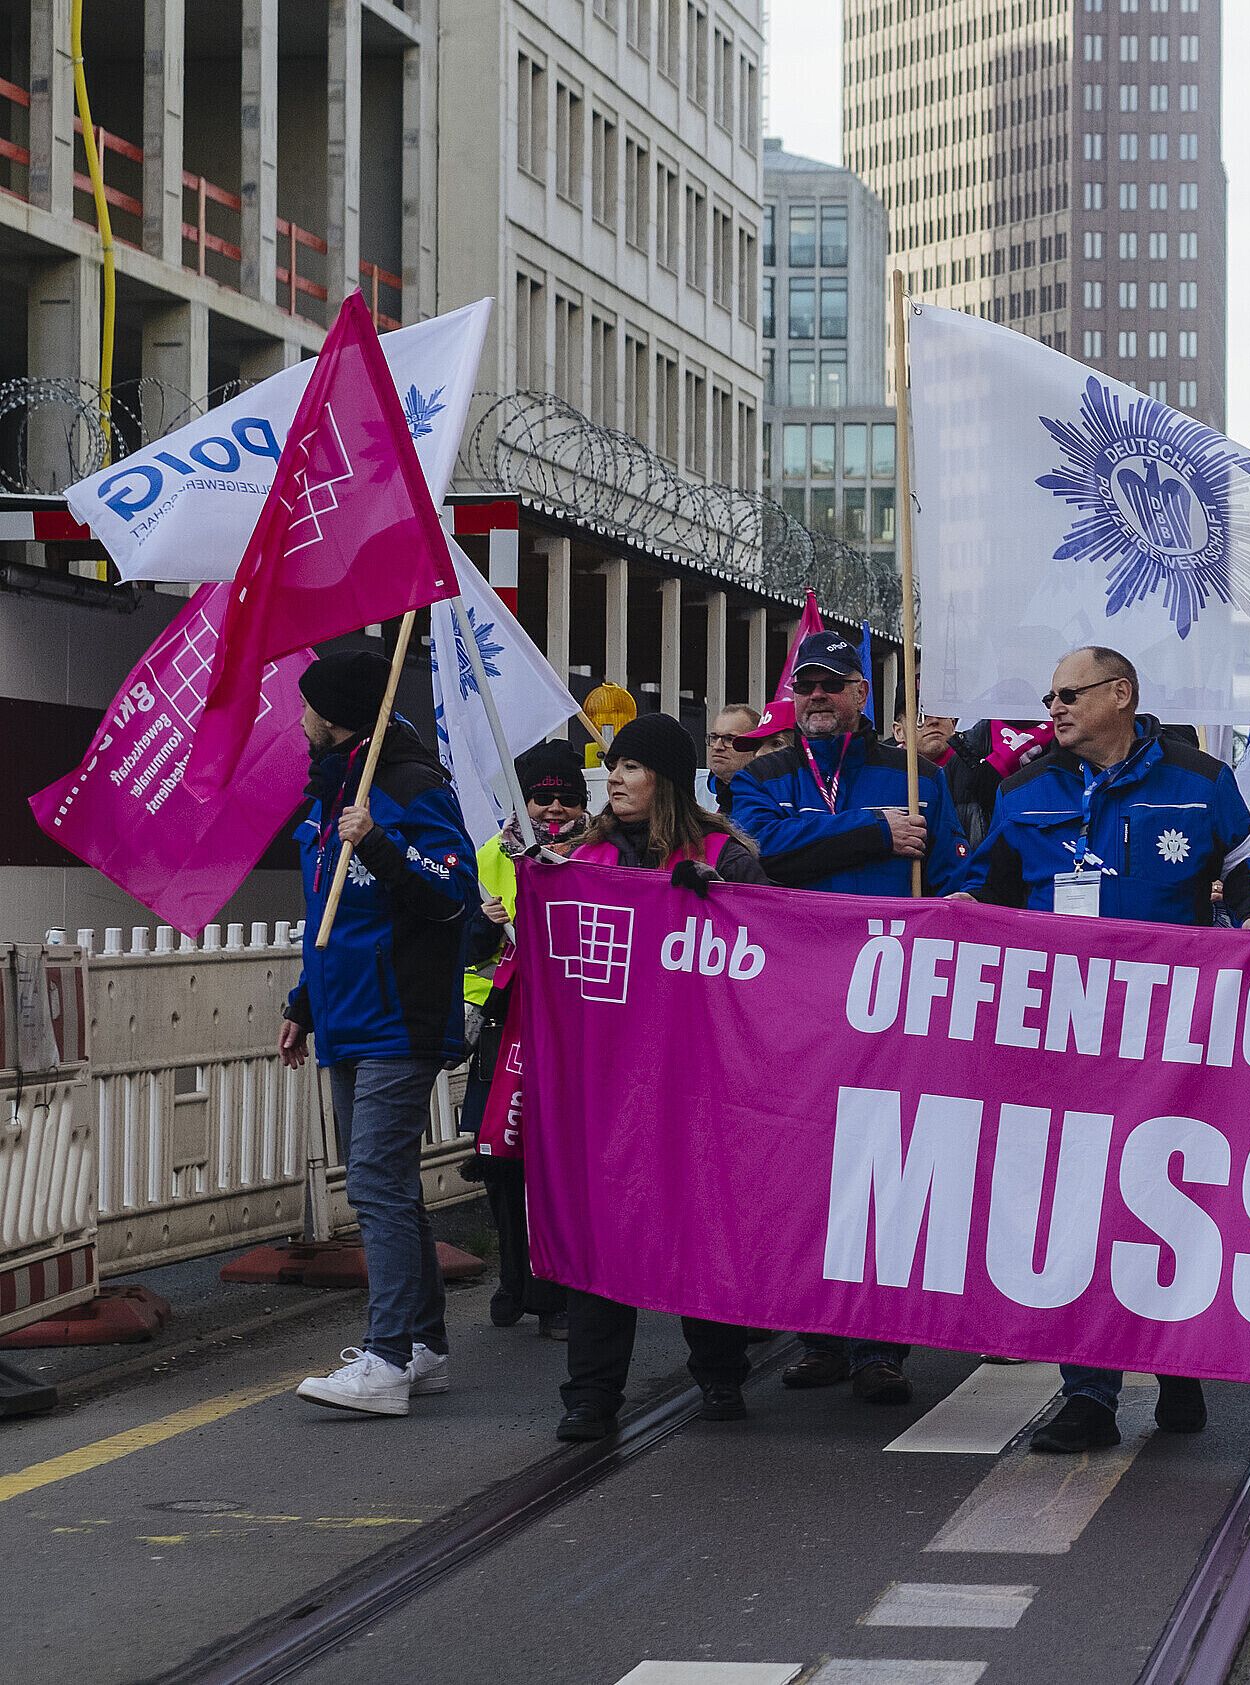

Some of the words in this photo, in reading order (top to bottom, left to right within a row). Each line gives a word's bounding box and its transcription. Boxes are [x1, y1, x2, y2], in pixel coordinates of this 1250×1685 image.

[1103, 438, 1197, 481] DEUTSCHE
[1096, 473, 1224, 570] POLIZEIGEWERKSCHAFT
[1151, 496, 1171, 539] DBB
[661, 916, 766, 981] dbb
